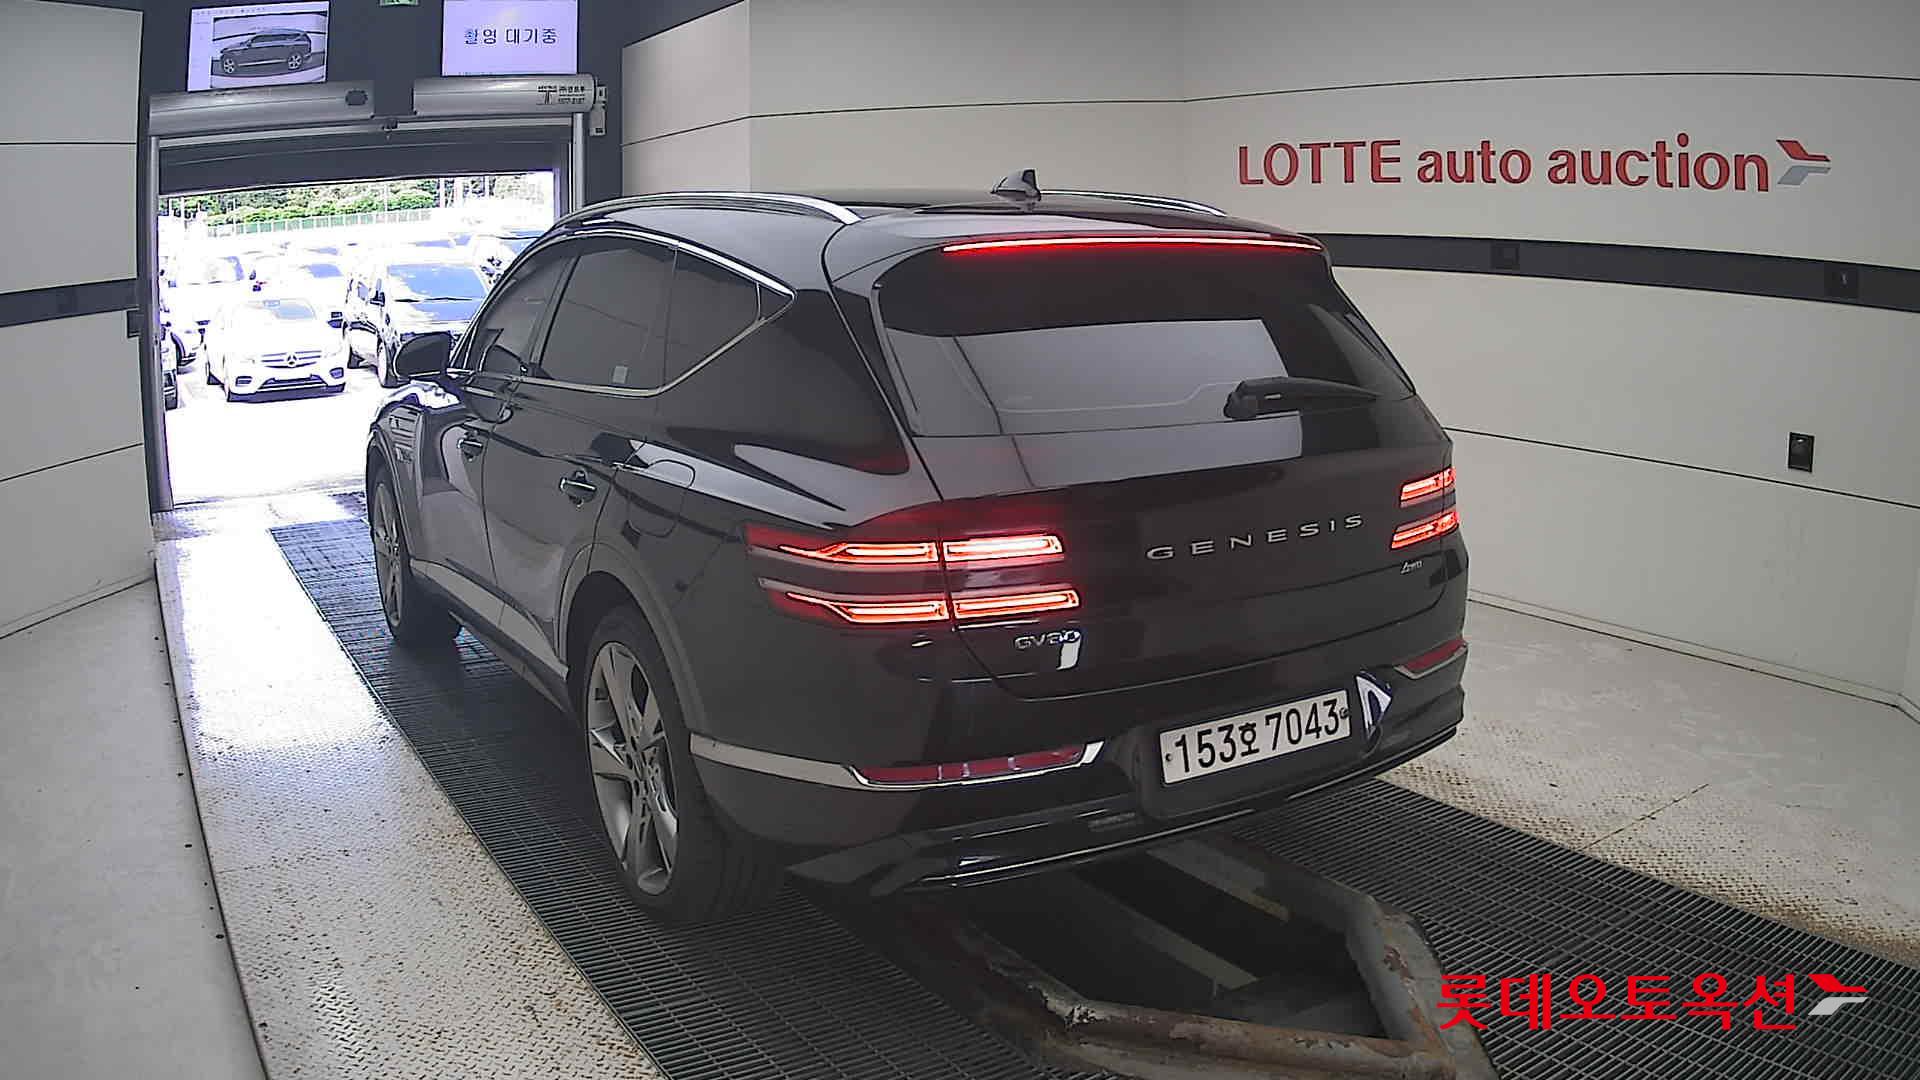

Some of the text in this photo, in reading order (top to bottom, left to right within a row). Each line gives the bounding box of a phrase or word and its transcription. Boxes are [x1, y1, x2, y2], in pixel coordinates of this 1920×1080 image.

[505, 28, 558, 45] 대기중
[1238, 133, 1770, 192] LOTTE auto auction
[1146, 514, 1363, 560] GENESIS
[1265, 698, 1340, 751] 7043
